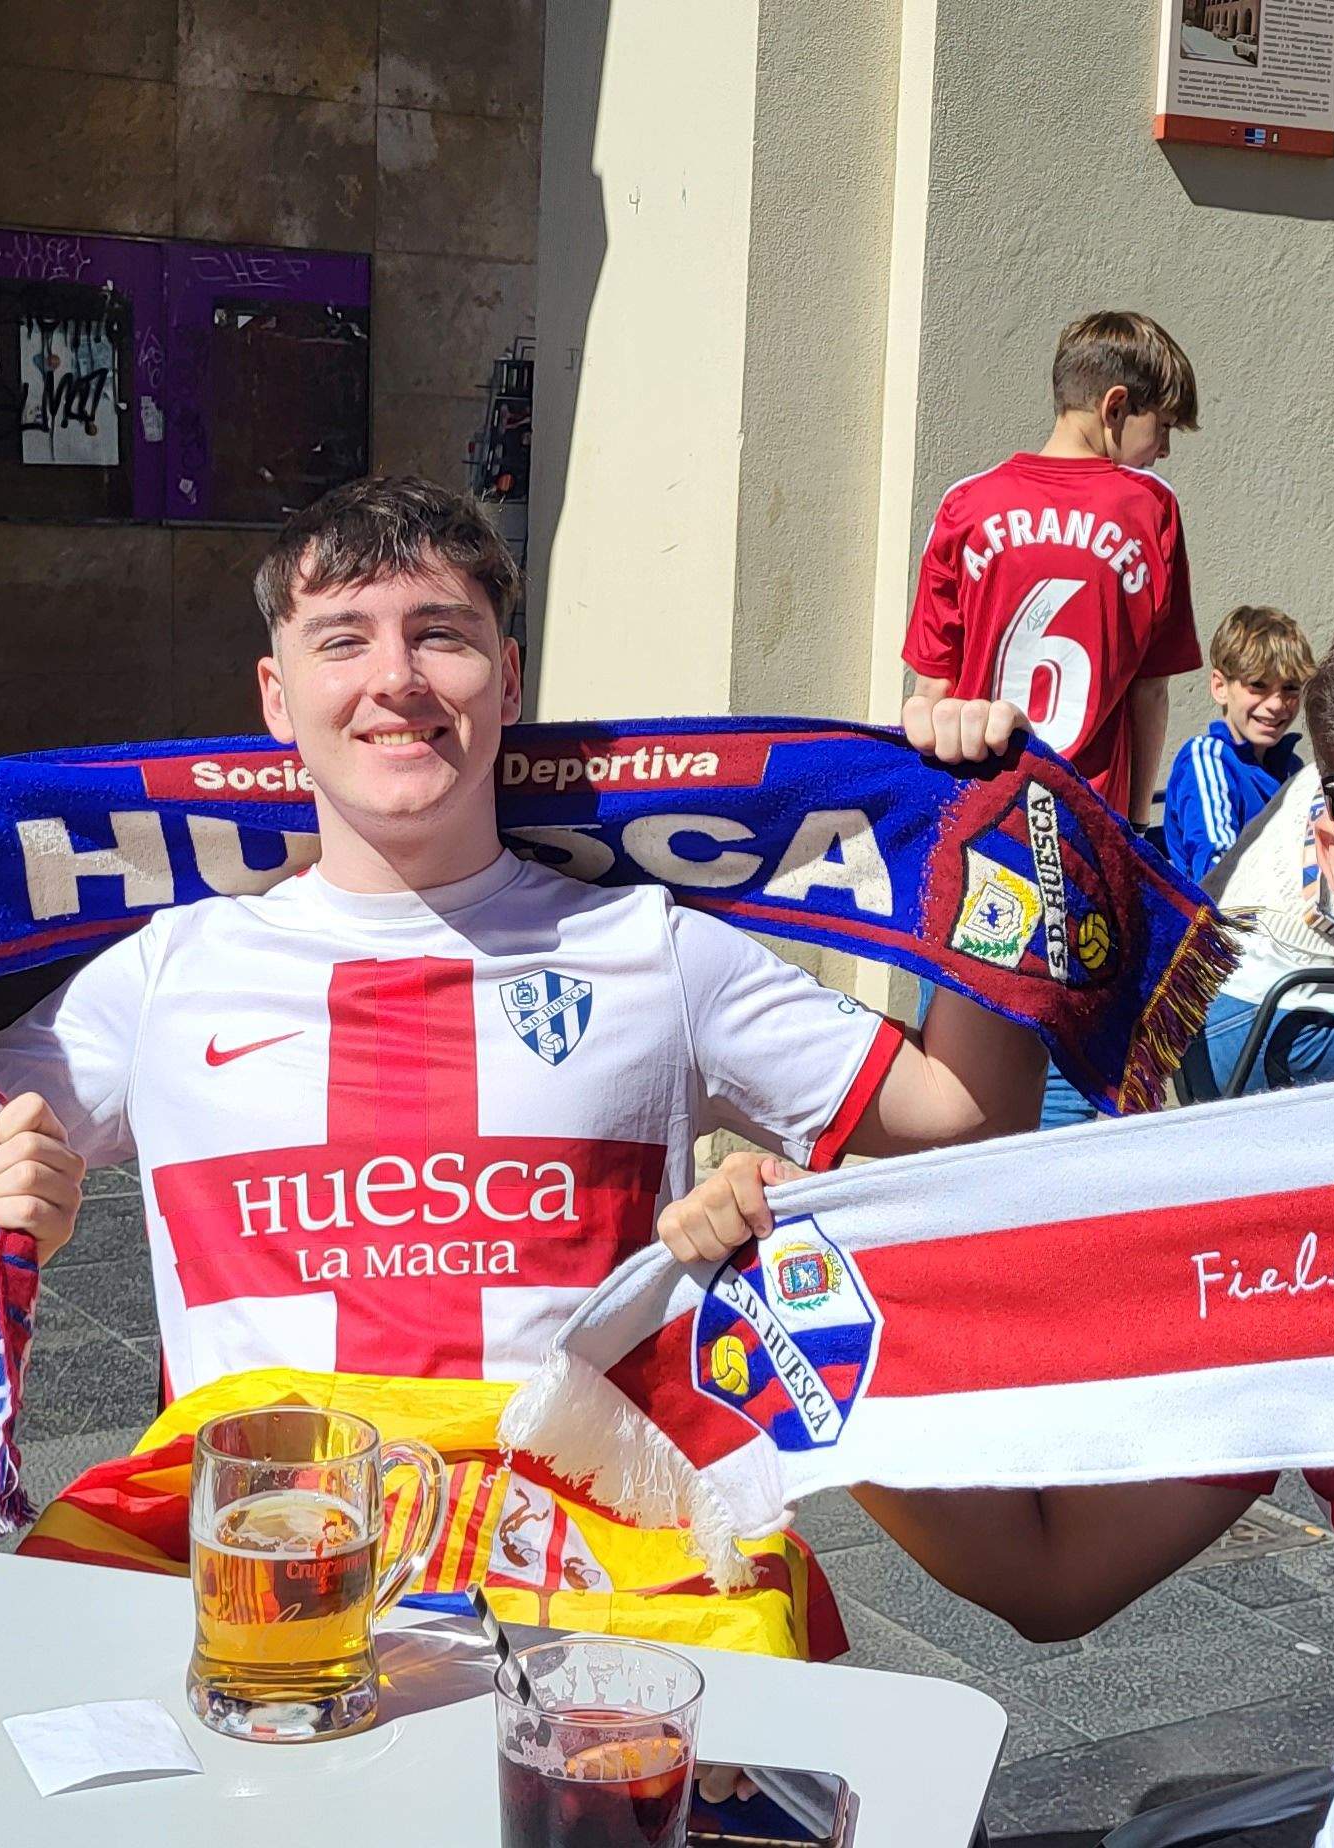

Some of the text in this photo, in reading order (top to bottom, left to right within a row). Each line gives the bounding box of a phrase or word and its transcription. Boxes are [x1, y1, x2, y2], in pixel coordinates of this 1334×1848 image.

[962, 507, 1150, 595] A.FRANCÉS
[994, 578, 1093, 757] 6
[190, 744, 720, 792] Socie Deportiva
[1031, 796, 1064, 911] HUESCA
[521, 987, 586, 1031] S.D. HUESCA
[726, 1278, 832, 1435] S.D. HUESCA
